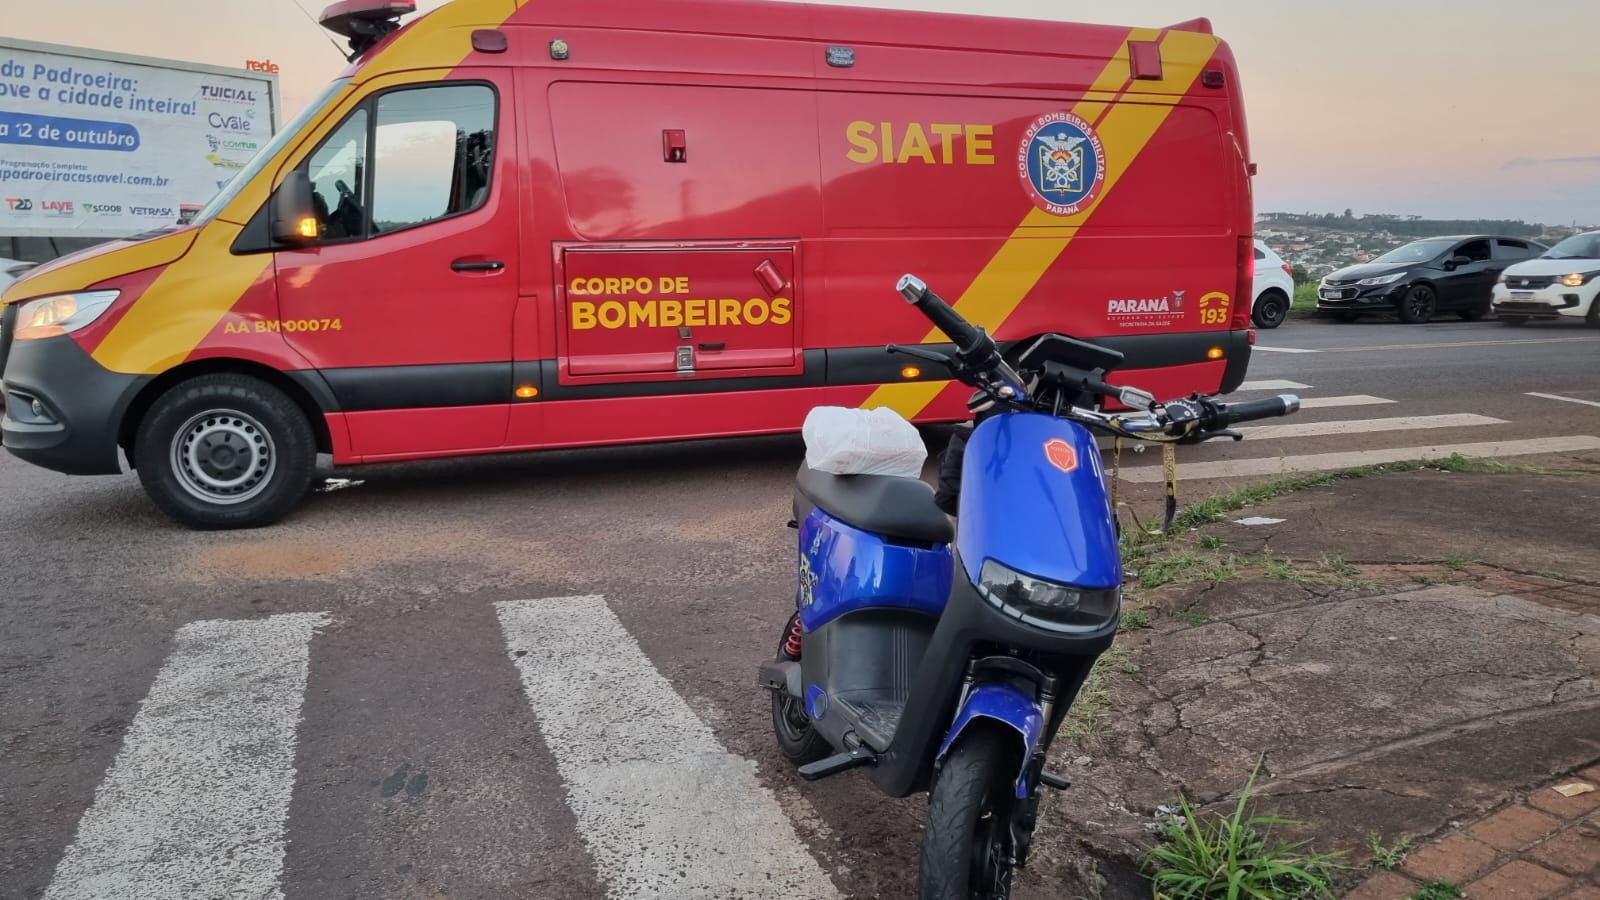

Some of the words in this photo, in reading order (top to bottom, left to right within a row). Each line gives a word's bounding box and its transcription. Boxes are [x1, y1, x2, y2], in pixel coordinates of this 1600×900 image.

[246, 60, 279, 74] rede
[1, 60, 24, 78] da
[33, 64, 138, 92] Padroeira:
[201, 85, 256, 101] TUICIAL
[38, 87, 51, 101] a
[58, 87, 124, 109] cidade
[129, 93, 197, 116] inteira!
[16, 122, 33, 138] 12
[38, 124, 61, 141] de
[65, 129, 136, 147] outubro
[845, 120, 995, 165] SIATE
[1019, 139, 1029, 178] CORPO
[1027, 124, 1038, 138] DE
[1038, 112, 1093, 136] BOMBEIROS
[1091, 136, 1105, 180] MILITAR
[41, 200, 74, 210] LAVE
[129, 206, 175, 216] VETRASA
[1046, 203, 1079, 214] PARANÁ
[571, 277, 653, 295] CORPO
[659, 276, 689, 293] DE
[1108, 297, 1169, 313] PARANÁ
[571, 298, 792, 329] BOMBEIROS
[1200, 308, 1228, 324] 193
[224, 321, 250, 334] AA
[255, 320, 281, 333] BM
[285, 319, 342, 332] 00074
